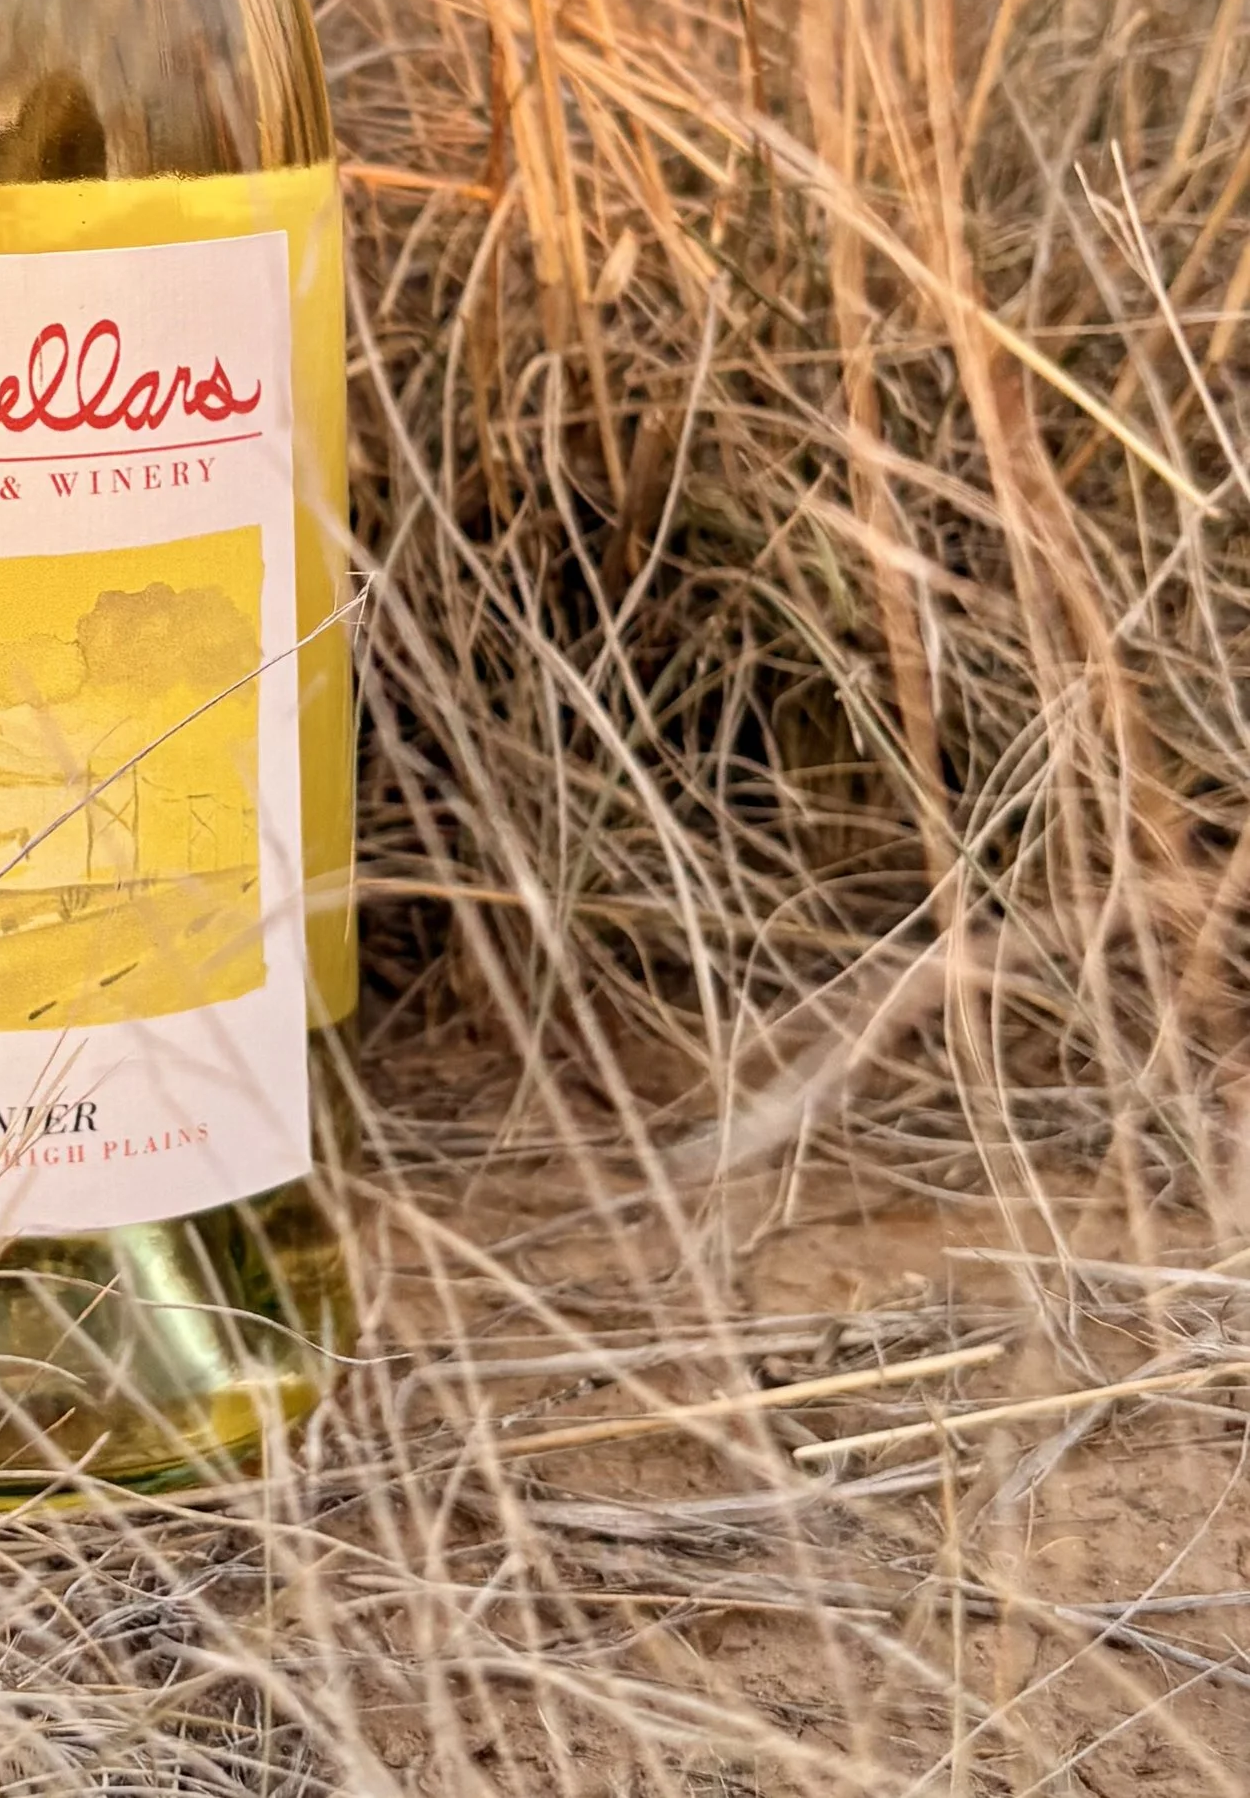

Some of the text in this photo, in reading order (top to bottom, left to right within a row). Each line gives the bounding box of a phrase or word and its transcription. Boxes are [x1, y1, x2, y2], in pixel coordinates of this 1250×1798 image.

[0, 476, 23, 501] &
[49, 458, 217, 499] WINERY
[102, 1123, 210, 1160] PLAINS
